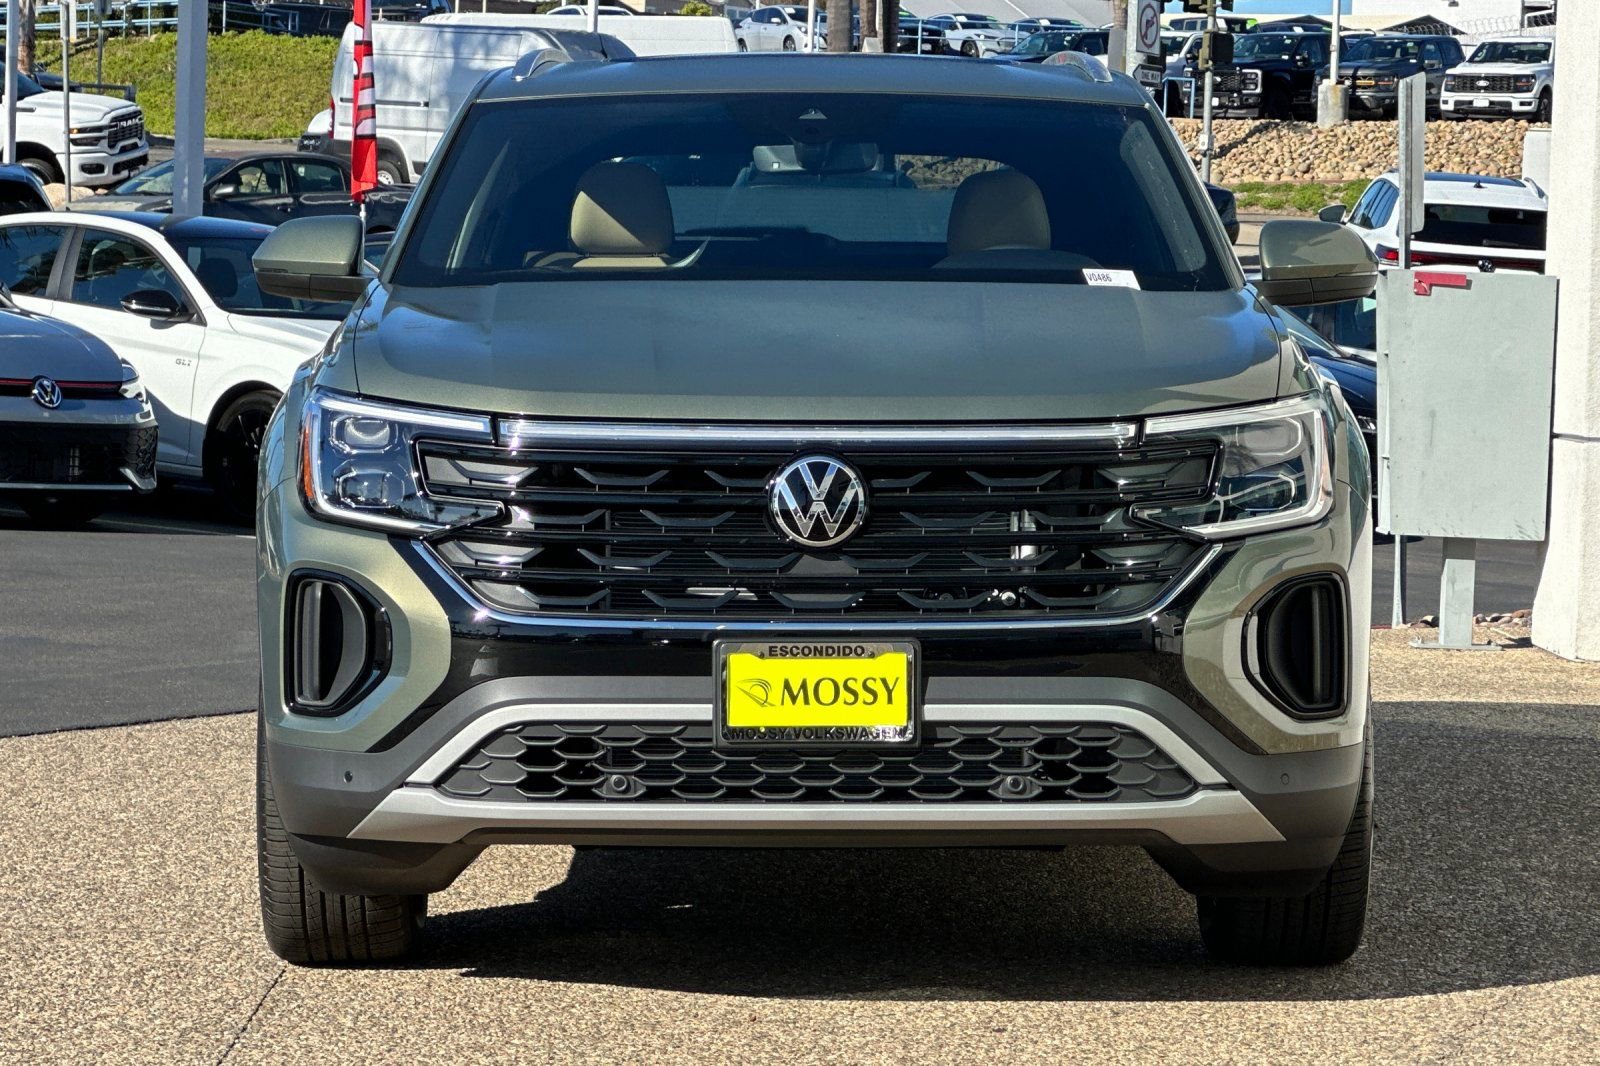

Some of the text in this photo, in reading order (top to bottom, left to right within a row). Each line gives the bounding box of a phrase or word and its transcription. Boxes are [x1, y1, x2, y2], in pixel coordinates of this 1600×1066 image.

[778, 461, 859, 538] VW
[768, 645, 865, 657] ESCONDIDO
[731, 726, 907, 740] MOSSY VOLKSWAGEN
